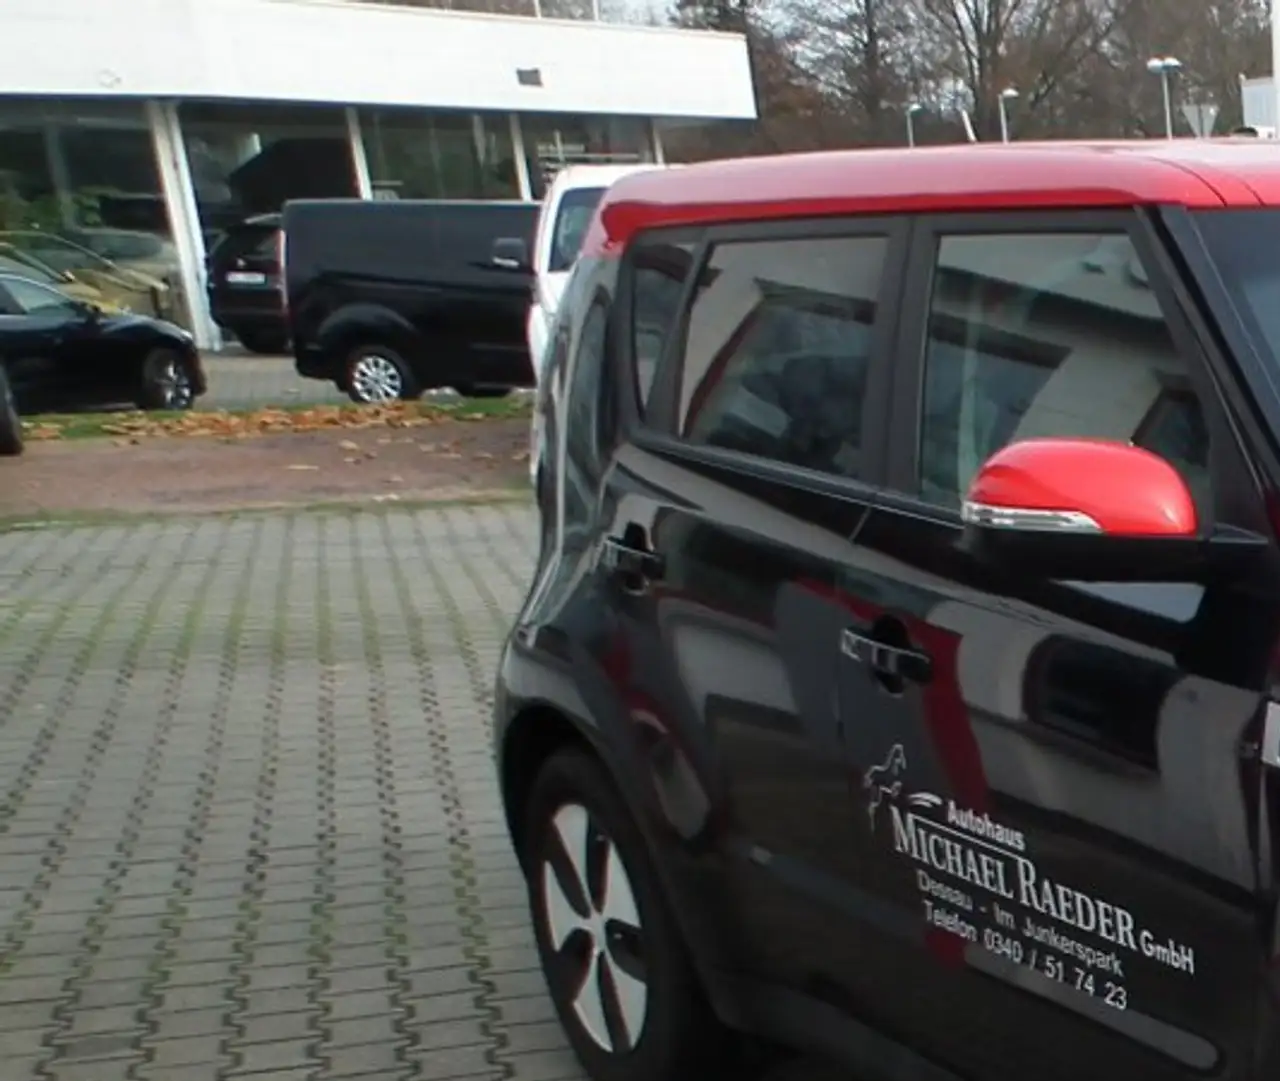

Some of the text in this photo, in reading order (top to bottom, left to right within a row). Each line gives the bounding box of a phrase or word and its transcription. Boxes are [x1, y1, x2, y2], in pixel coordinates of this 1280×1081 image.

[947, 799, 1025, 851] Autohaus
[916, 868, 974, 912] Dessau
[1022, 916, 1125, 978] Junkerspark
[923, 899, 978, 942] Telefon
[983, 928, 1024, 964] 0340
[1044, 955, 1064, 983] 51
[1074, 966, 1096, 997] 74
[1104, 981, 1128, 1011] 23
[1139, 929, 1195, 976] GmbH
